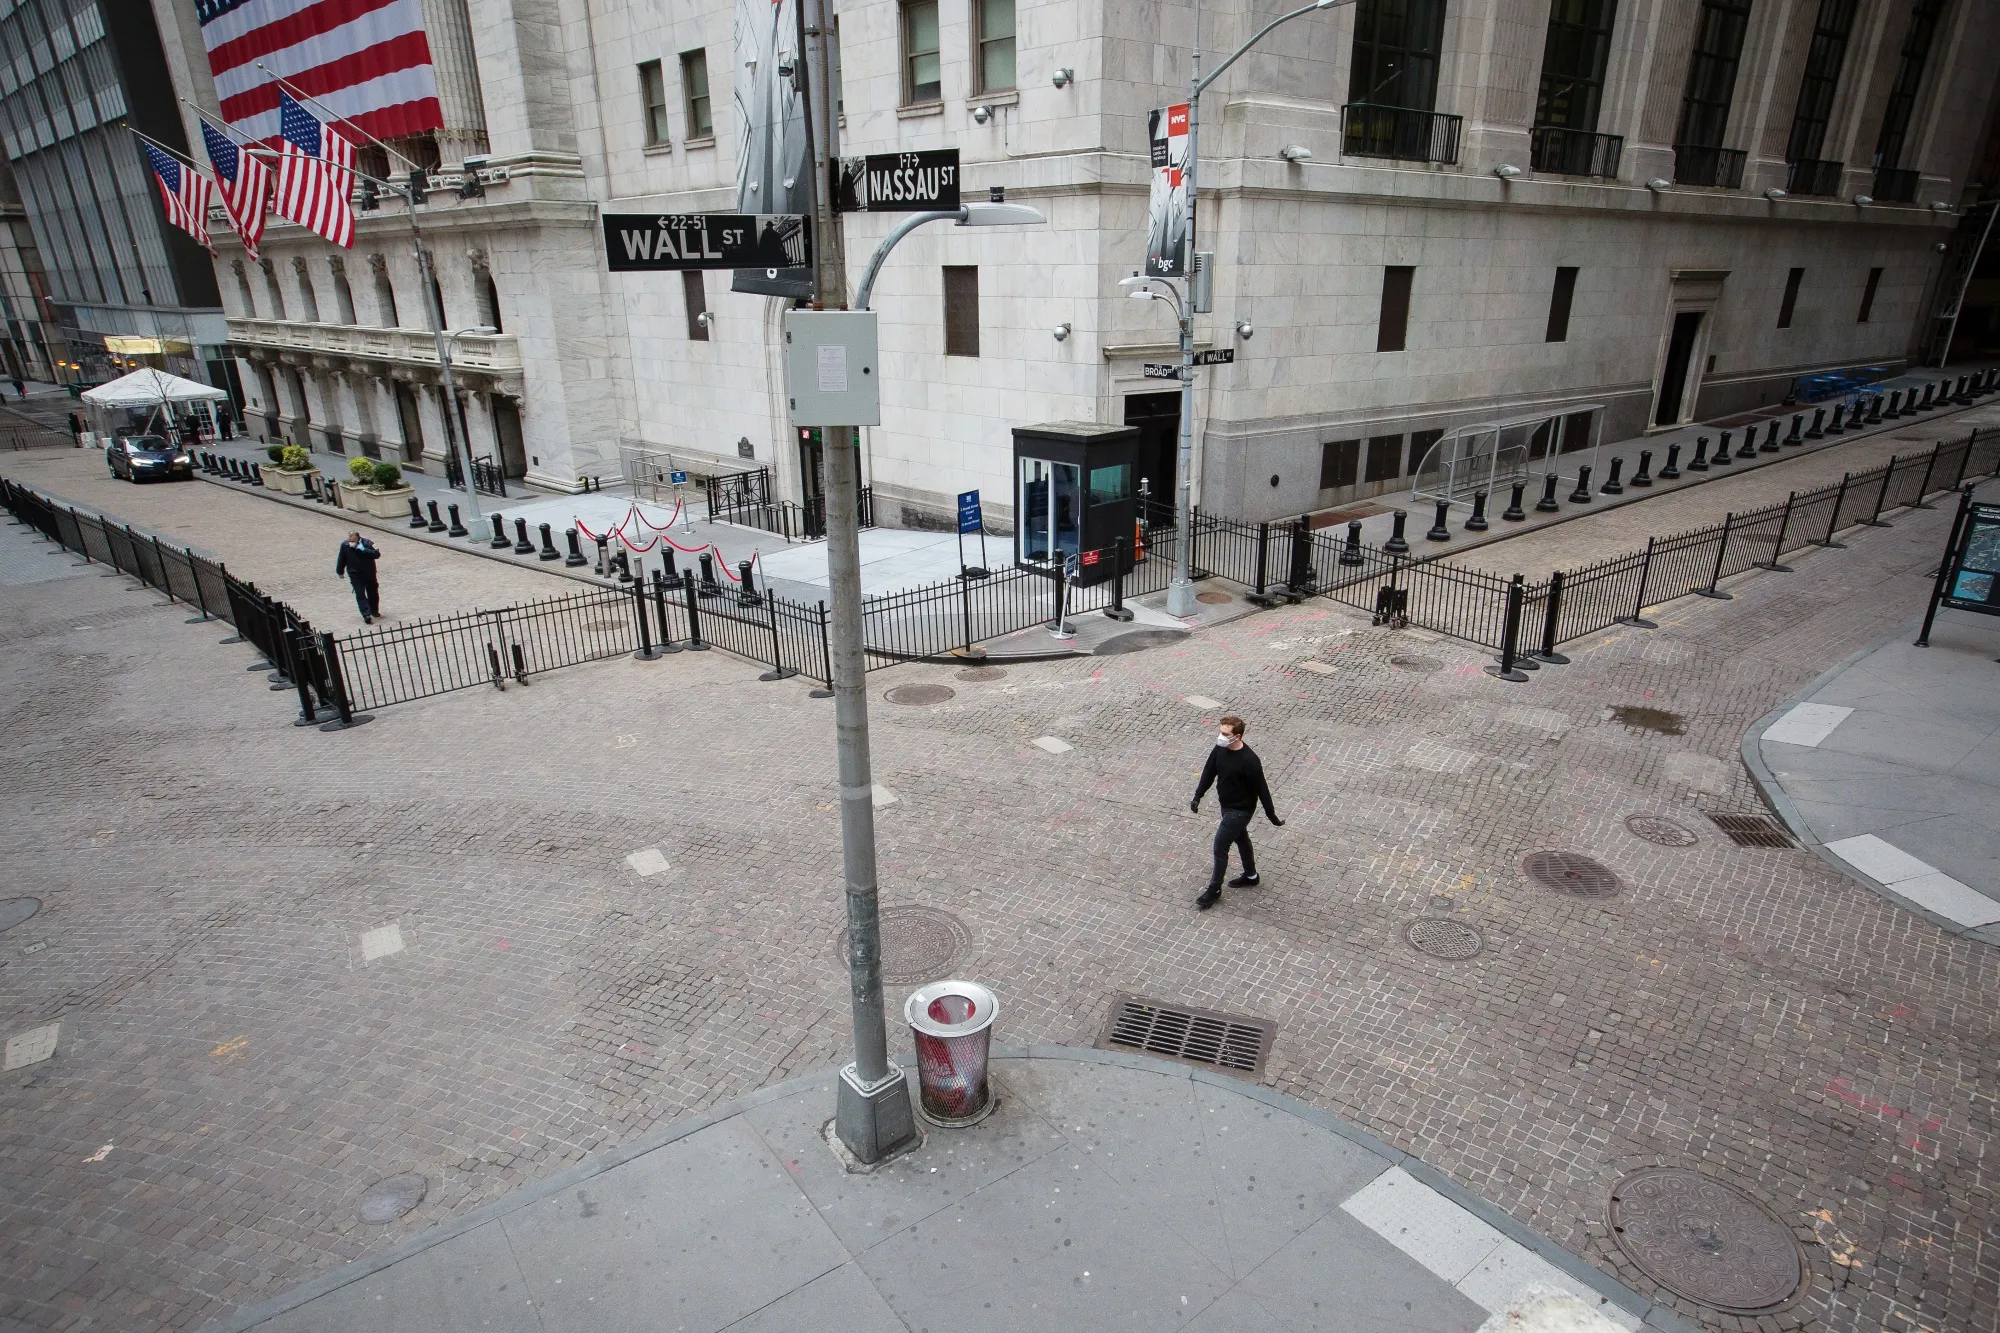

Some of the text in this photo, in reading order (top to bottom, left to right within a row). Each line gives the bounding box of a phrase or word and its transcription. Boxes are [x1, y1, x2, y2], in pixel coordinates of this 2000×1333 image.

[1171, 114, 1186, 124] NYC
[899, 154, 911, 168] 1-7
[870, 166, 955, 201] NASSAU ST
[670, 216, 707, 230] 22-51
[620, 229, 744, 260] WALL ST
[1158, 256, 1174, 272] bgc
[1207, 352, 1227, 362] WALL
[1145, 367, 1168, 377] BROAD
